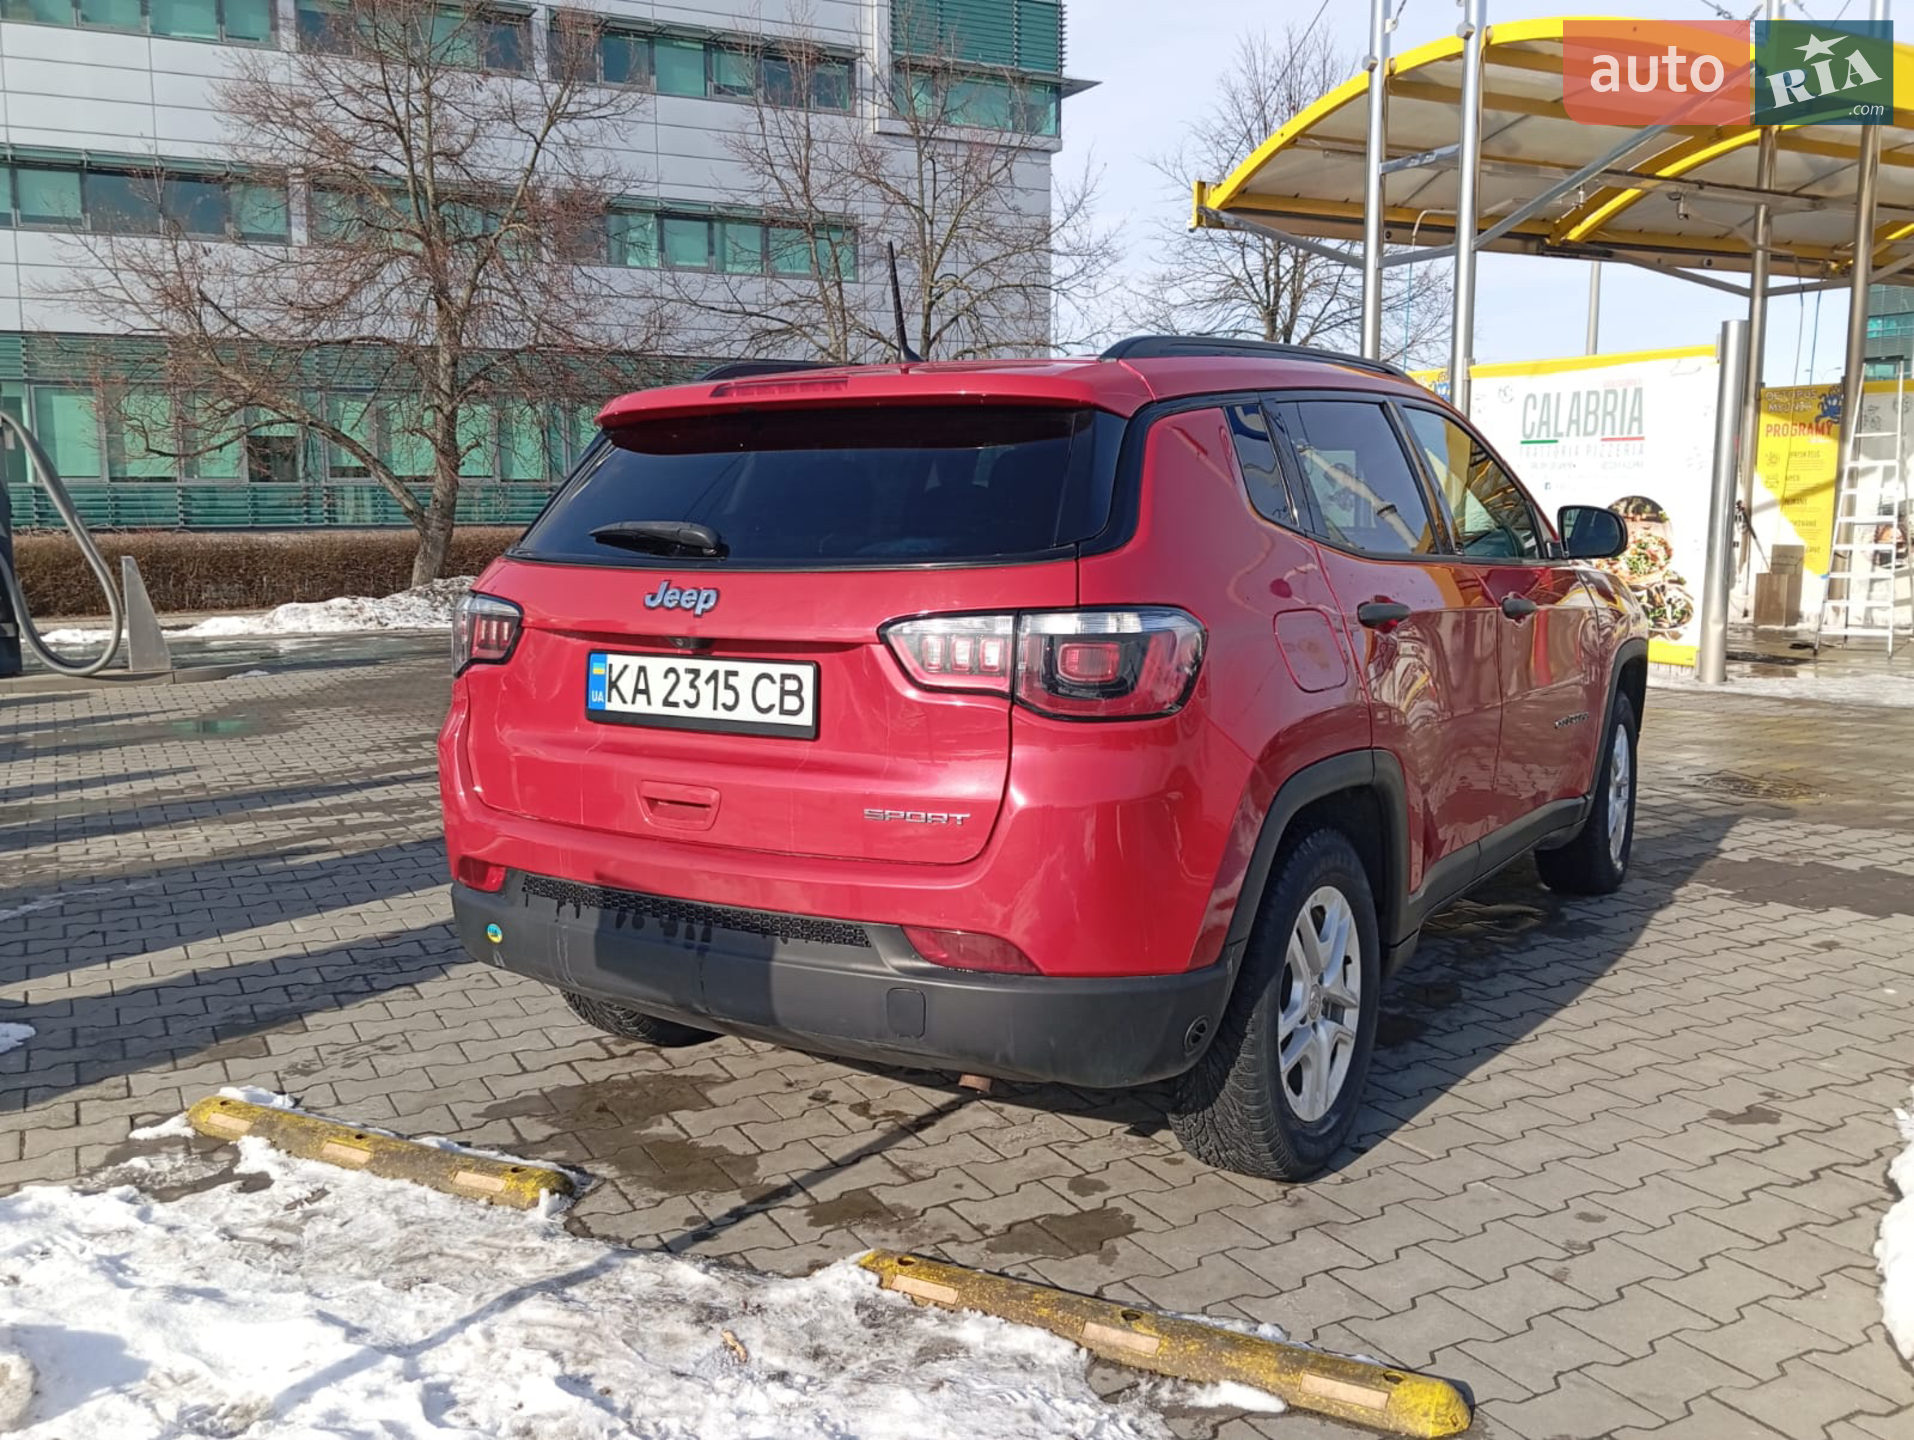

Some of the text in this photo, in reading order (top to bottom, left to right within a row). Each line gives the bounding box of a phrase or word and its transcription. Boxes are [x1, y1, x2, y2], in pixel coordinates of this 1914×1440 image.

[1521, 387, 1644, 440] CALABRIA
[1765, 421, 1834, 438] PROGRAMY
[1519, 443, 1644, 459] TRATTORIA PIZZERIA
[644, 580, 720, 617] Jeep
[591, 690, 605, 703] UA
[606, 662, 805, 716] KA 2315 CB
[863, 808, 971, 825] SPORT
